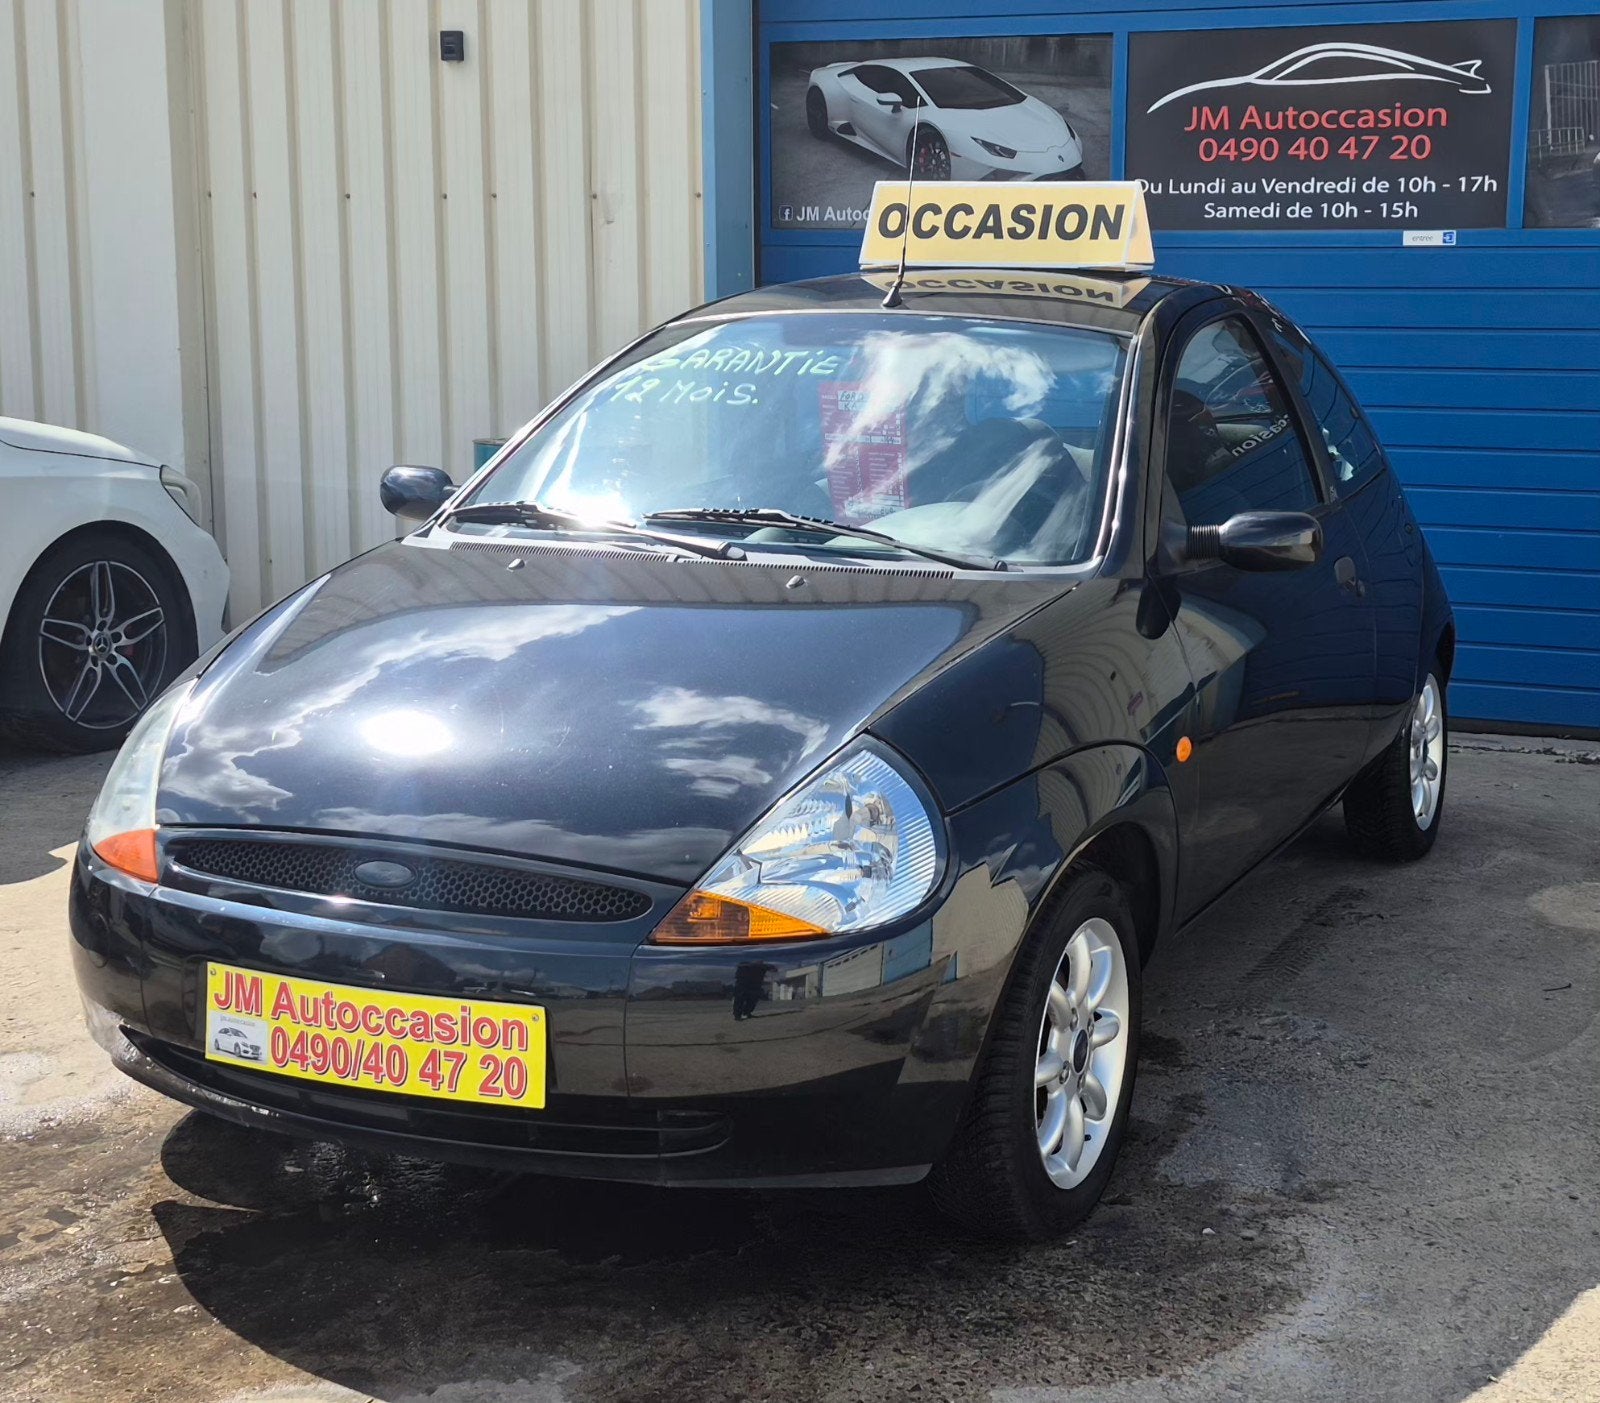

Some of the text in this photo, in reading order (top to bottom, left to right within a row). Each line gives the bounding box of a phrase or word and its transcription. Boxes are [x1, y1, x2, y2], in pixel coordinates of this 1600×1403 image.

[1184, 103, 1447, 131] JM Autoccasion
[1198, 134, 1432, 162] 0490 40 47 20
[1169, 177, 1225, 194] Lundi
[1231, 181, 1256, 194] au
[1261, 176, 1359, 194] Vendredi
[1363, 176, 1389, 193] de
[1398, 176, 1436, 193] 10h
[1458, 175, 1498, 192] 17h
[796, 206, 820, 221] JM
[878, 202, 1125, 240] OCCASION
[1203, 201, 1280, 218] Samedi
[1286, 201, 1312, 218] de
[1320, 201, 1358, 218] 10h
[1380, 201, 1418, 217] 15h
[213, 970, 529, 1051] JM Autoccasion
[270, 1026, 528, 1099] 0490/40 47 20
